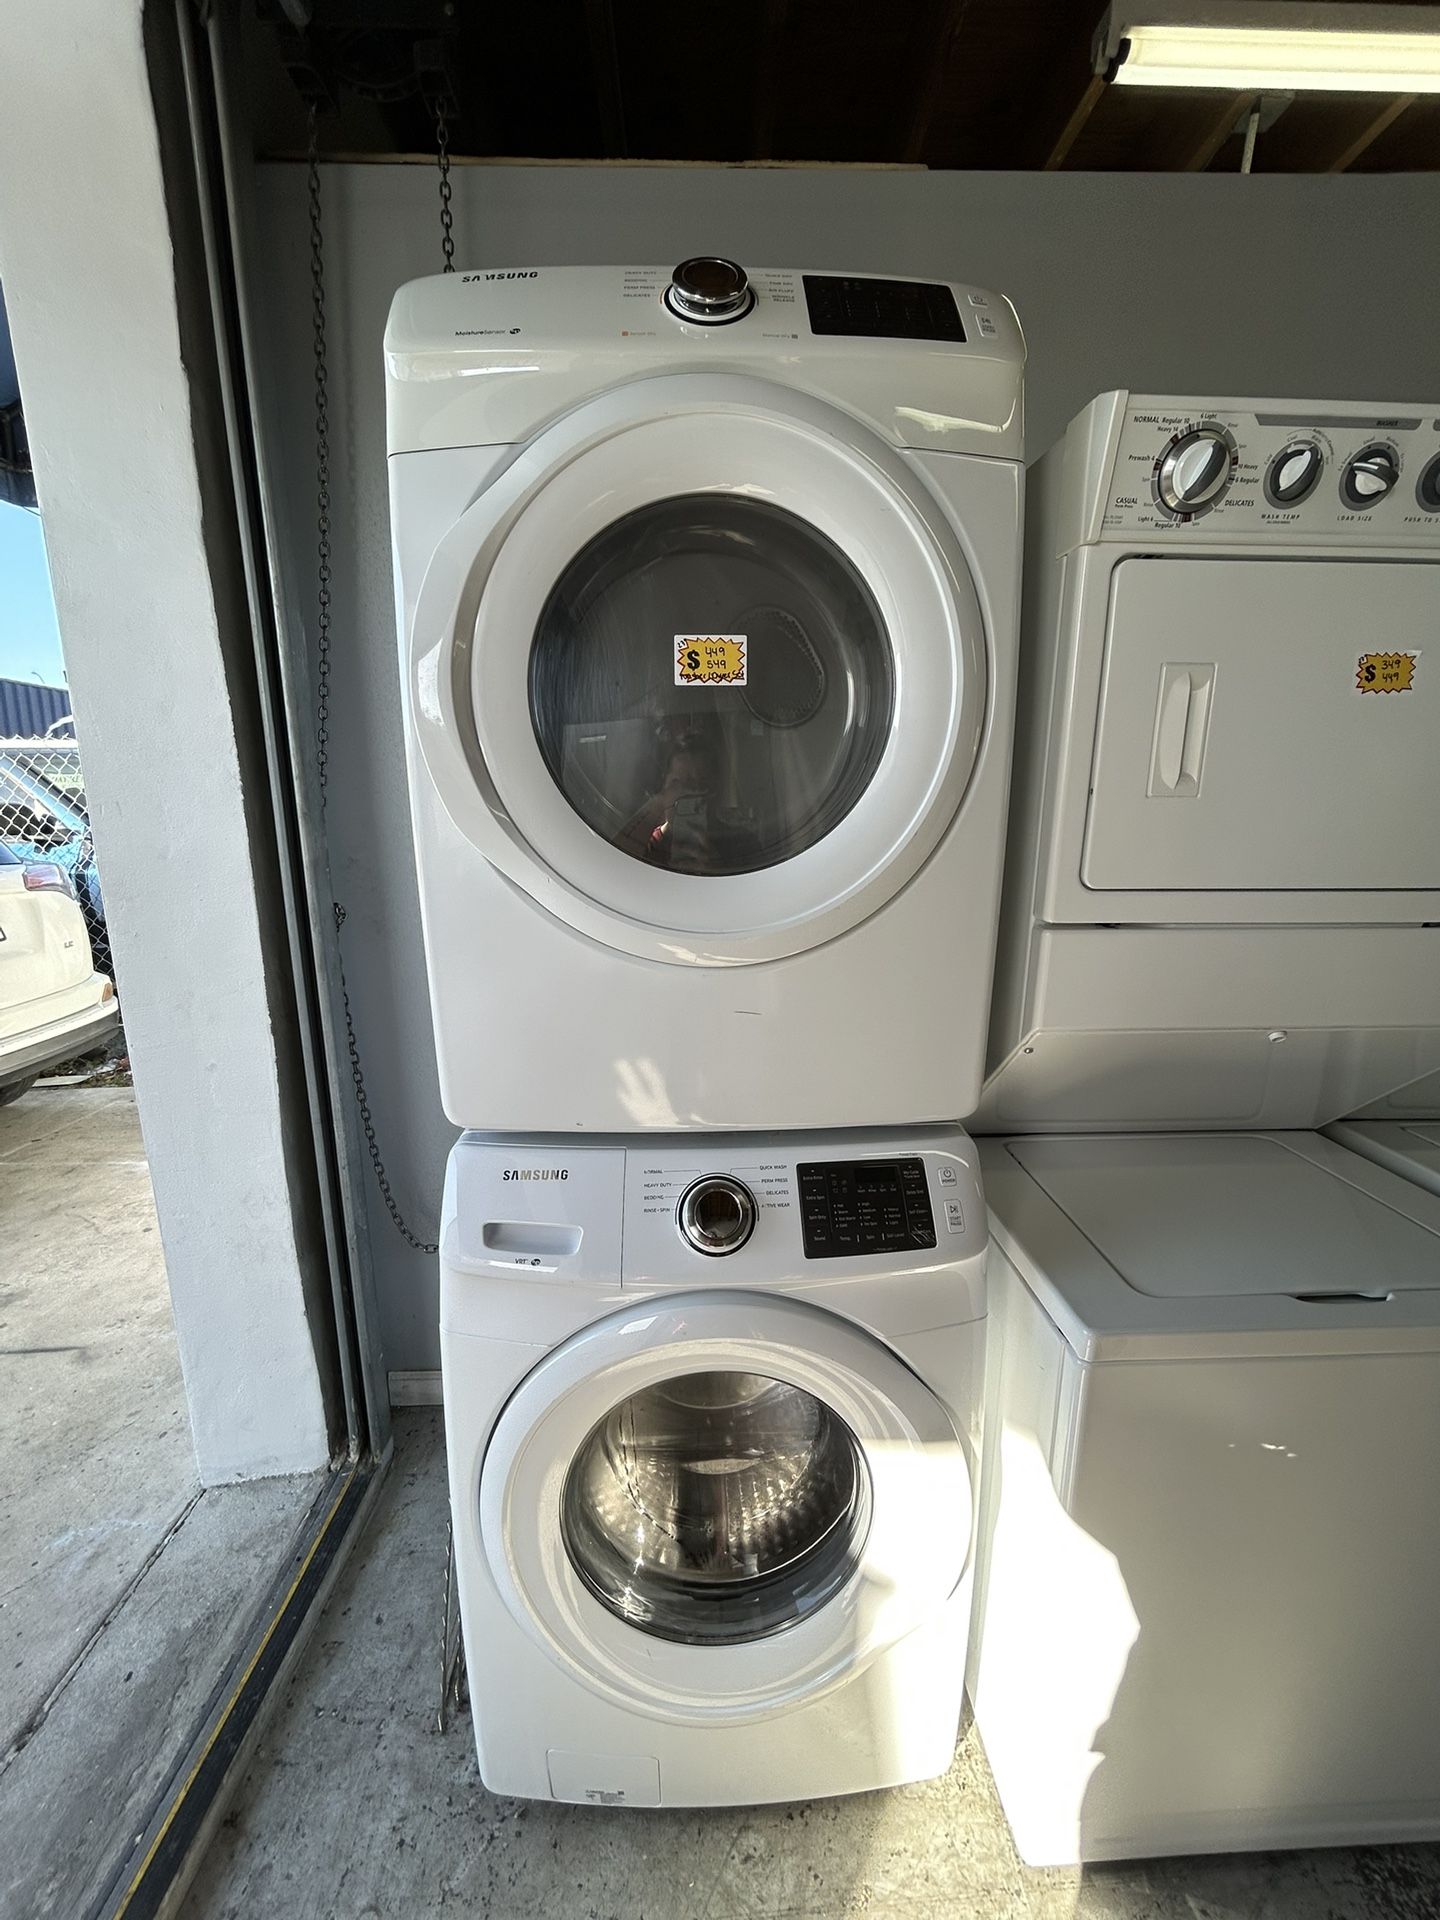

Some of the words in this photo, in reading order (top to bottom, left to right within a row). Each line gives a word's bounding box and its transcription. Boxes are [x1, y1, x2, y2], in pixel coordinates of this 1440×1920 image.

[1134, 416, 1161, 424] NORMAL
[1162, 417, 1183, 426] Regular
[1128, 454, 1151, 463] Prewash
[1240, 477, 1261, 486] Regular
[1115, 497, 1139, 505] CASUAL
[1225, 500, 1256, 508] DELICATES
[1154, 523, 1175, 531] Regular
[687, 649, 701, 671] $
[705, 646, 726, 658] 449
[707, 659, 727, 669] 549
[1364, 664, 1377, 684] $
[1381, 659, 1402, 670] 349
[1382, 672, 1400, 683] 449
[503, 1169, 569, 1181] SAMSUNG
